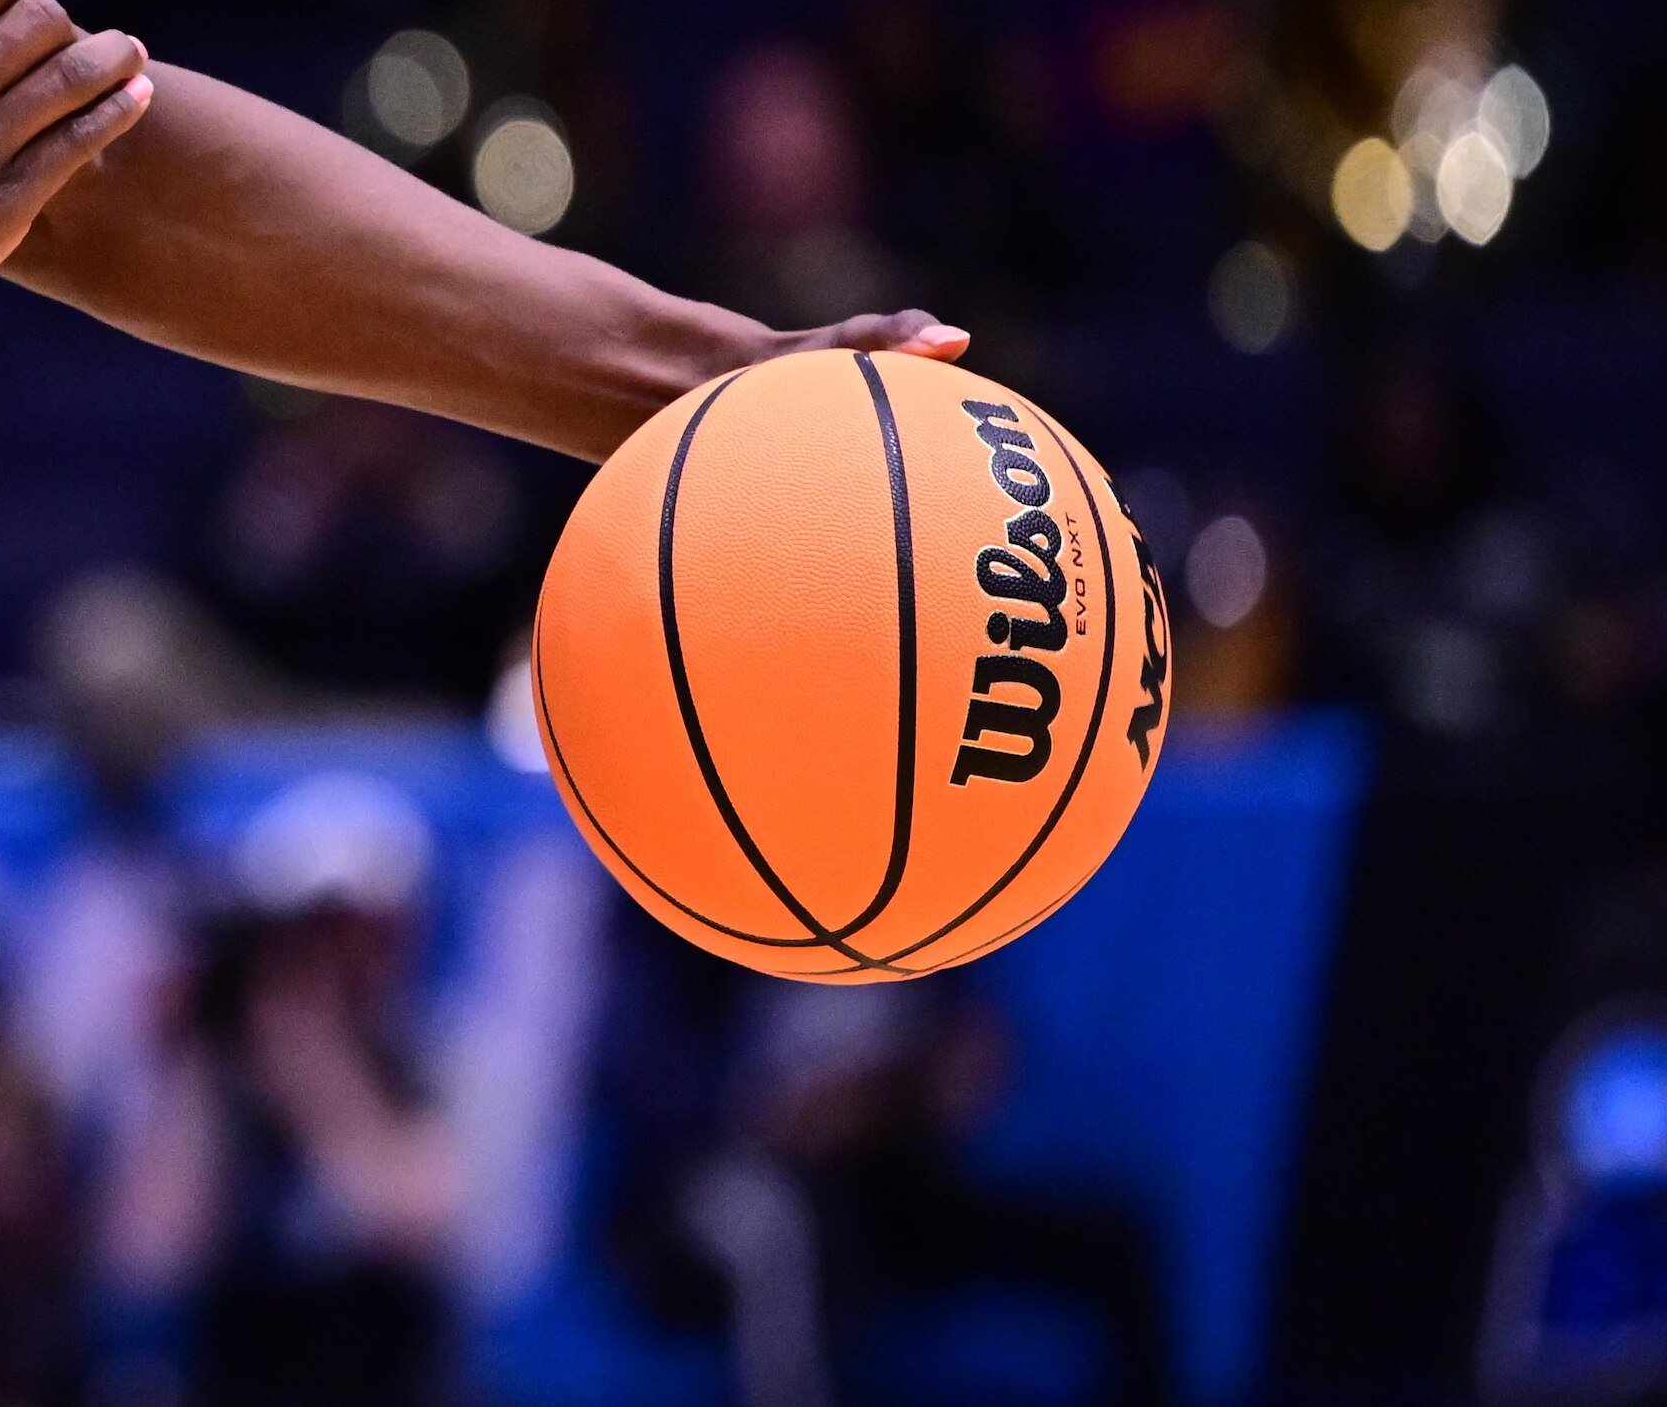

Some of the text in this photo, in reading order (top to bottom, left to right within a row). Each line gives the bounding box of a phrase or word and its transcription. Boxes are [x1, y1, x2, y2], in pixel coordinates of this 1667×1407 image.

[949, 398, 1069, 786] Wilson
[1065, 512, 1086, 635] EVO NXT
